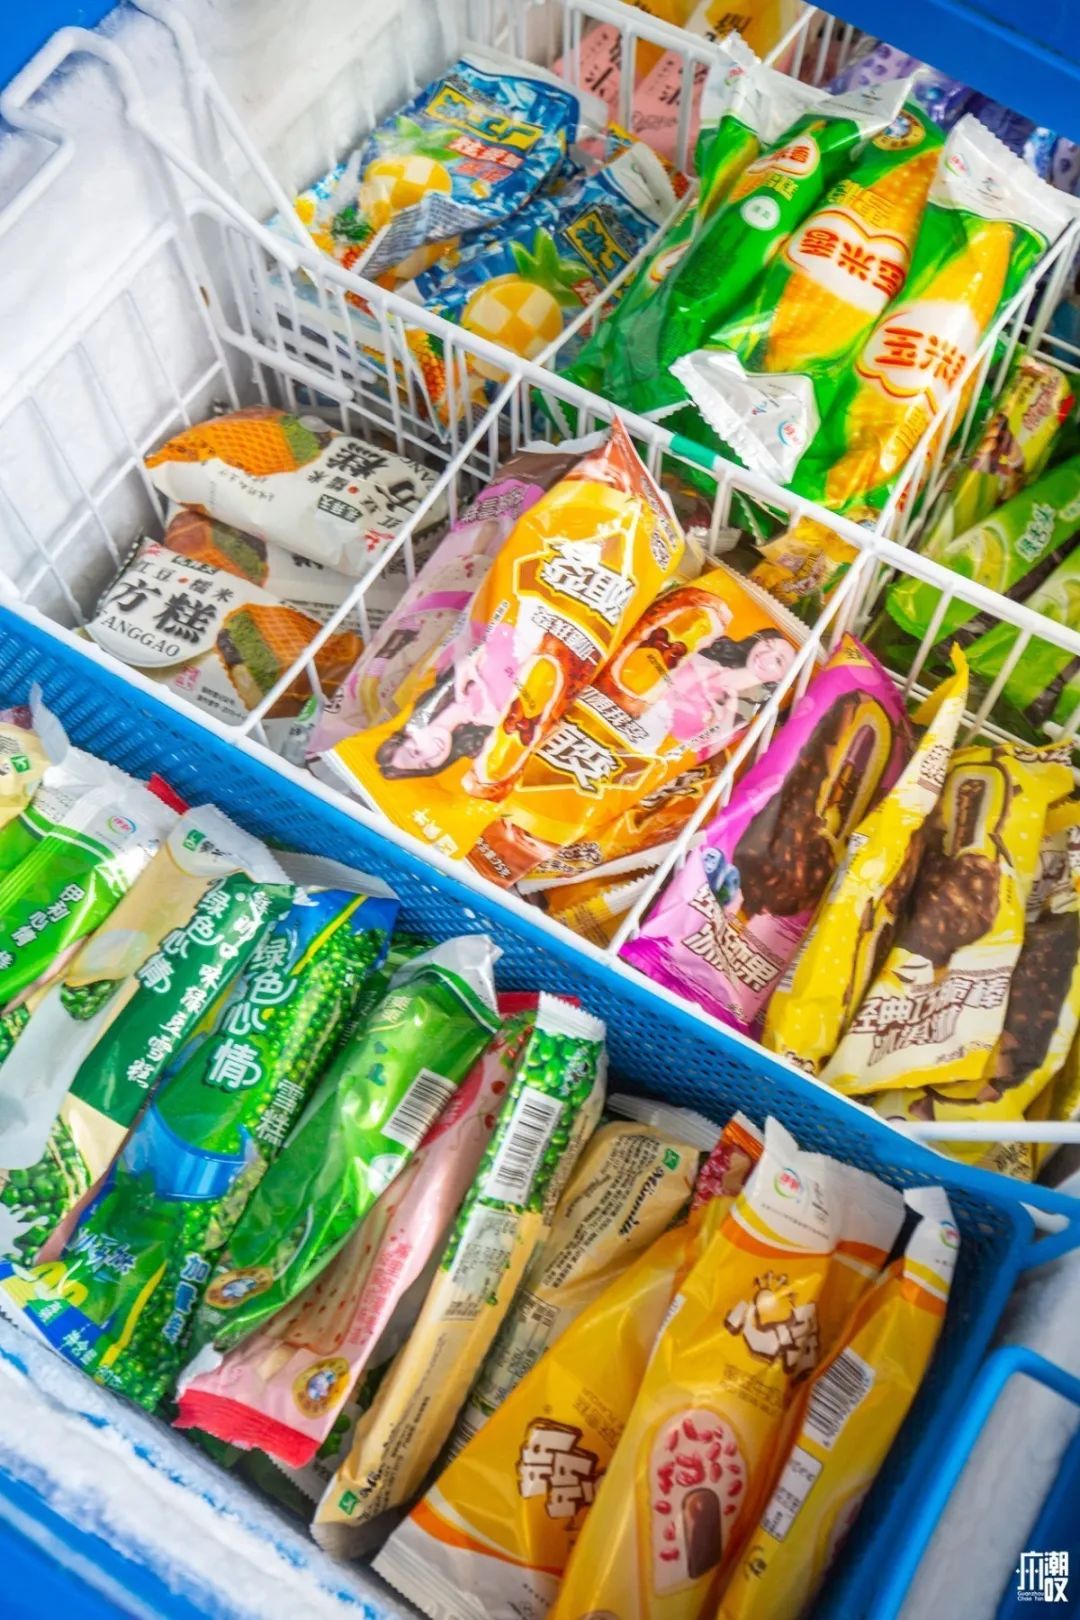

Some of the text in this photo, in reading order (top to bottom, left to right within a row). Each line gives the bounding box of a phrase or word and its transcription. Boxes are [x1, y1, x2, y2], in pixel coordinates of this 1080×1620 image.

[100, 608, 181, 657] ANGGAO
[111, 578, 218, 644] 方糕
[208, 938, 298, 1089] 绿色心情
